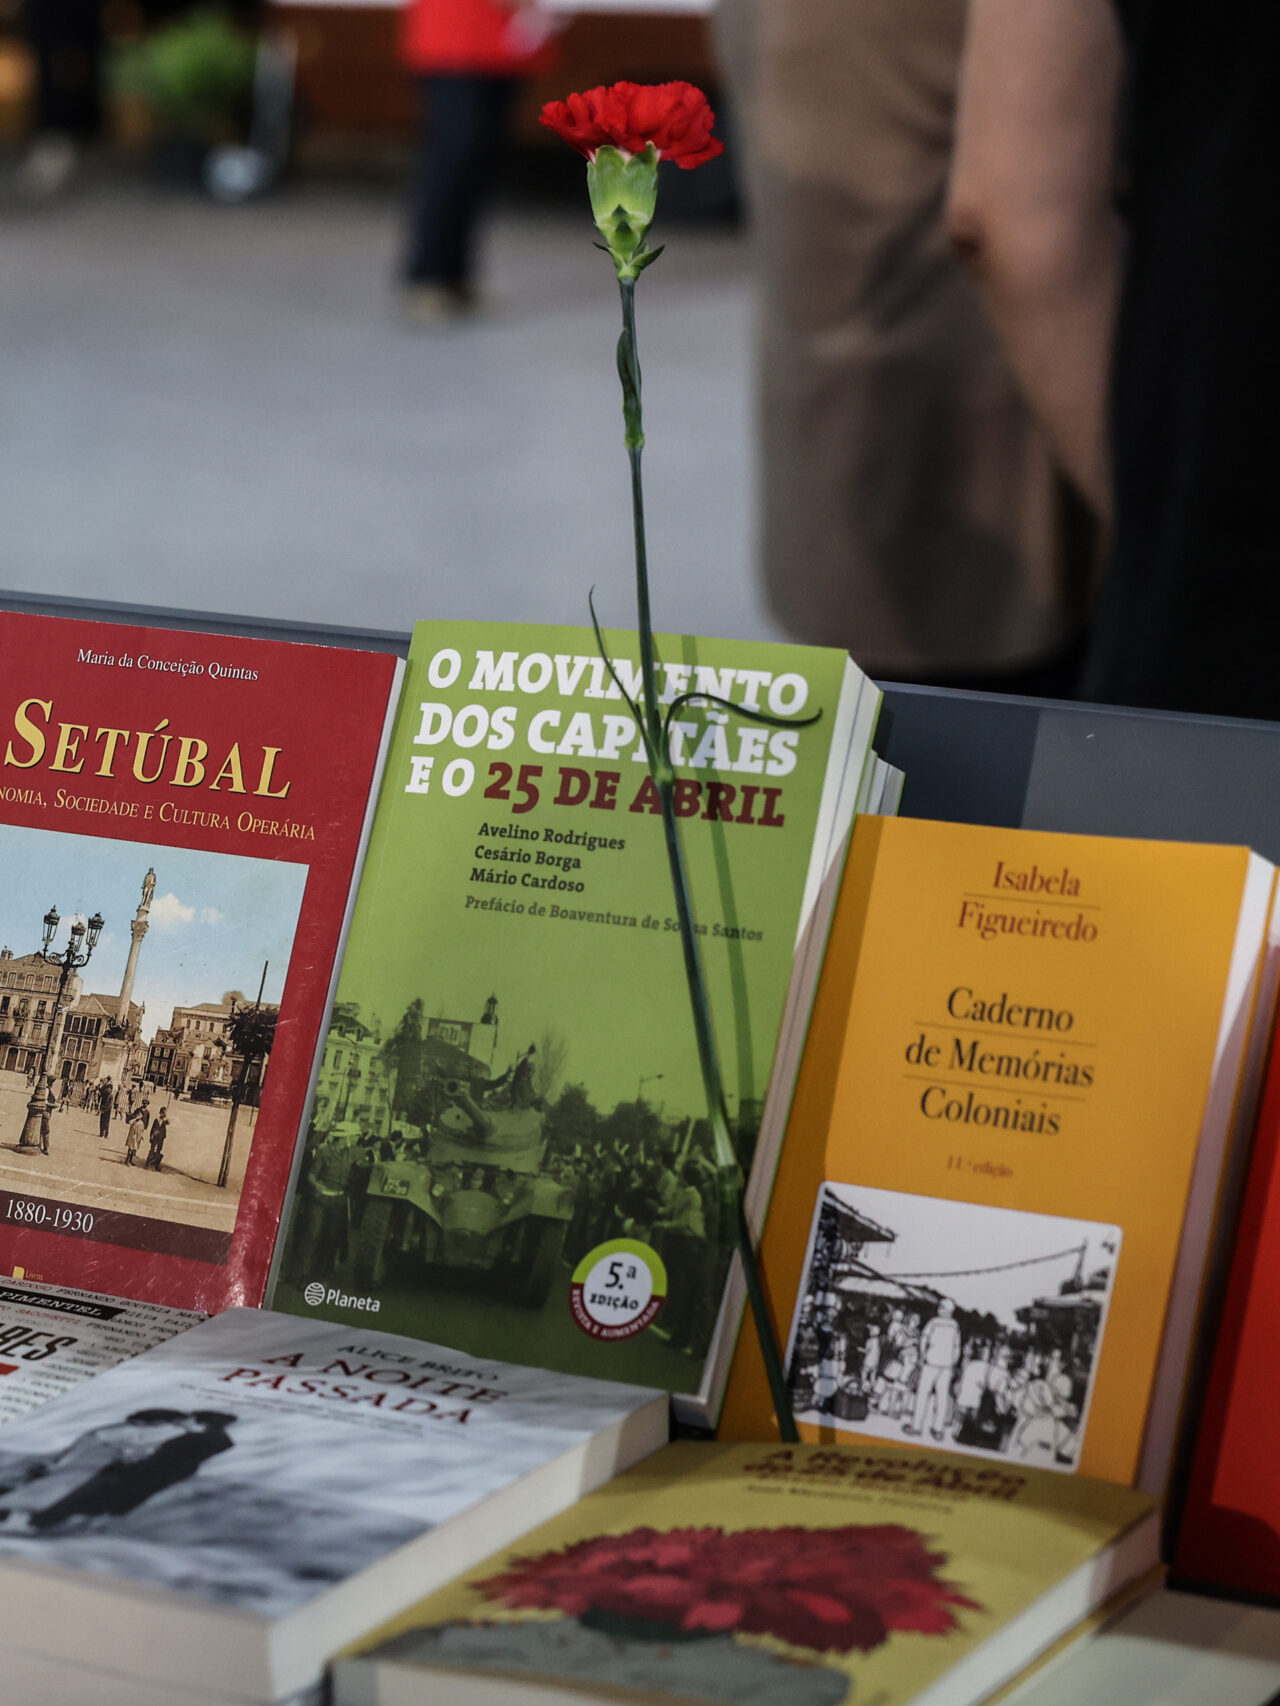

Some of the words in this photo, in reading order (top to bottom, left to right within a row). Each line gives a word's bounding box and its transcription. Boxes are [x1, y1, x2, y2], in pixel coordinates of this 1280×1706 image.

[77, 648, 115, 667] Maria
[118, 653, 134, 669] da
[137, 655, 205, 678] Conceição
[208, 662, 259, 682] Quintas
[428, 648, 462, 689] O
[468, 650, 809, 716] MOVIMENTO
[414, 702, 518, 750] DOS
[404, 755, 435, 794] E
[441, 757, 475, 797] O
[483, 762, 544, 814] 25
[553, 766, 621, 811] DE
[629, 774, 785, 828] ABRIL
[474, 845, 532, 865] Cesário
[535, 850, 582, 870] Borga
[478, 822, 540, 842] Avelino
[543, 828, 626, 851] Rodrigues
[469, 867, 518, 887] Mário
[521, 872, 585, 893] Cardoso
[992, 861, 1081, 897] Isabela
[465, 895, 525, 914] Prefácio
[528, 902, 546, 916] de
[549, 904, 637, 928] Boaventura
[641, 915, 660, 930] de
[663, 918, 708, 936] Sosa
[711, 924, 764, 943] Santos
[957, 900, 1099, 942] Figueiredo
[947, 986, 1075, 1033] Caderno
[905, 1033, 942, 1068] de
[948, 1036, 1094, 1088] Memórias
[920, 1085, 1062, 1136] Coloniais
[6, 1198, 95, 1234] 1880-1930
[326, 1288, 381, 1313] Planeta
[589, 1294, 639, 1311] EDIÇÃO
[261, 1352, 307, 1368] A
[320, 1359, 509, 1402] NOITE
[337, 1344, 417, 1365] ALICE
[420, 1360, 499, 1382] BRITO
[219, 1367, 473, 1424] PASSADA
